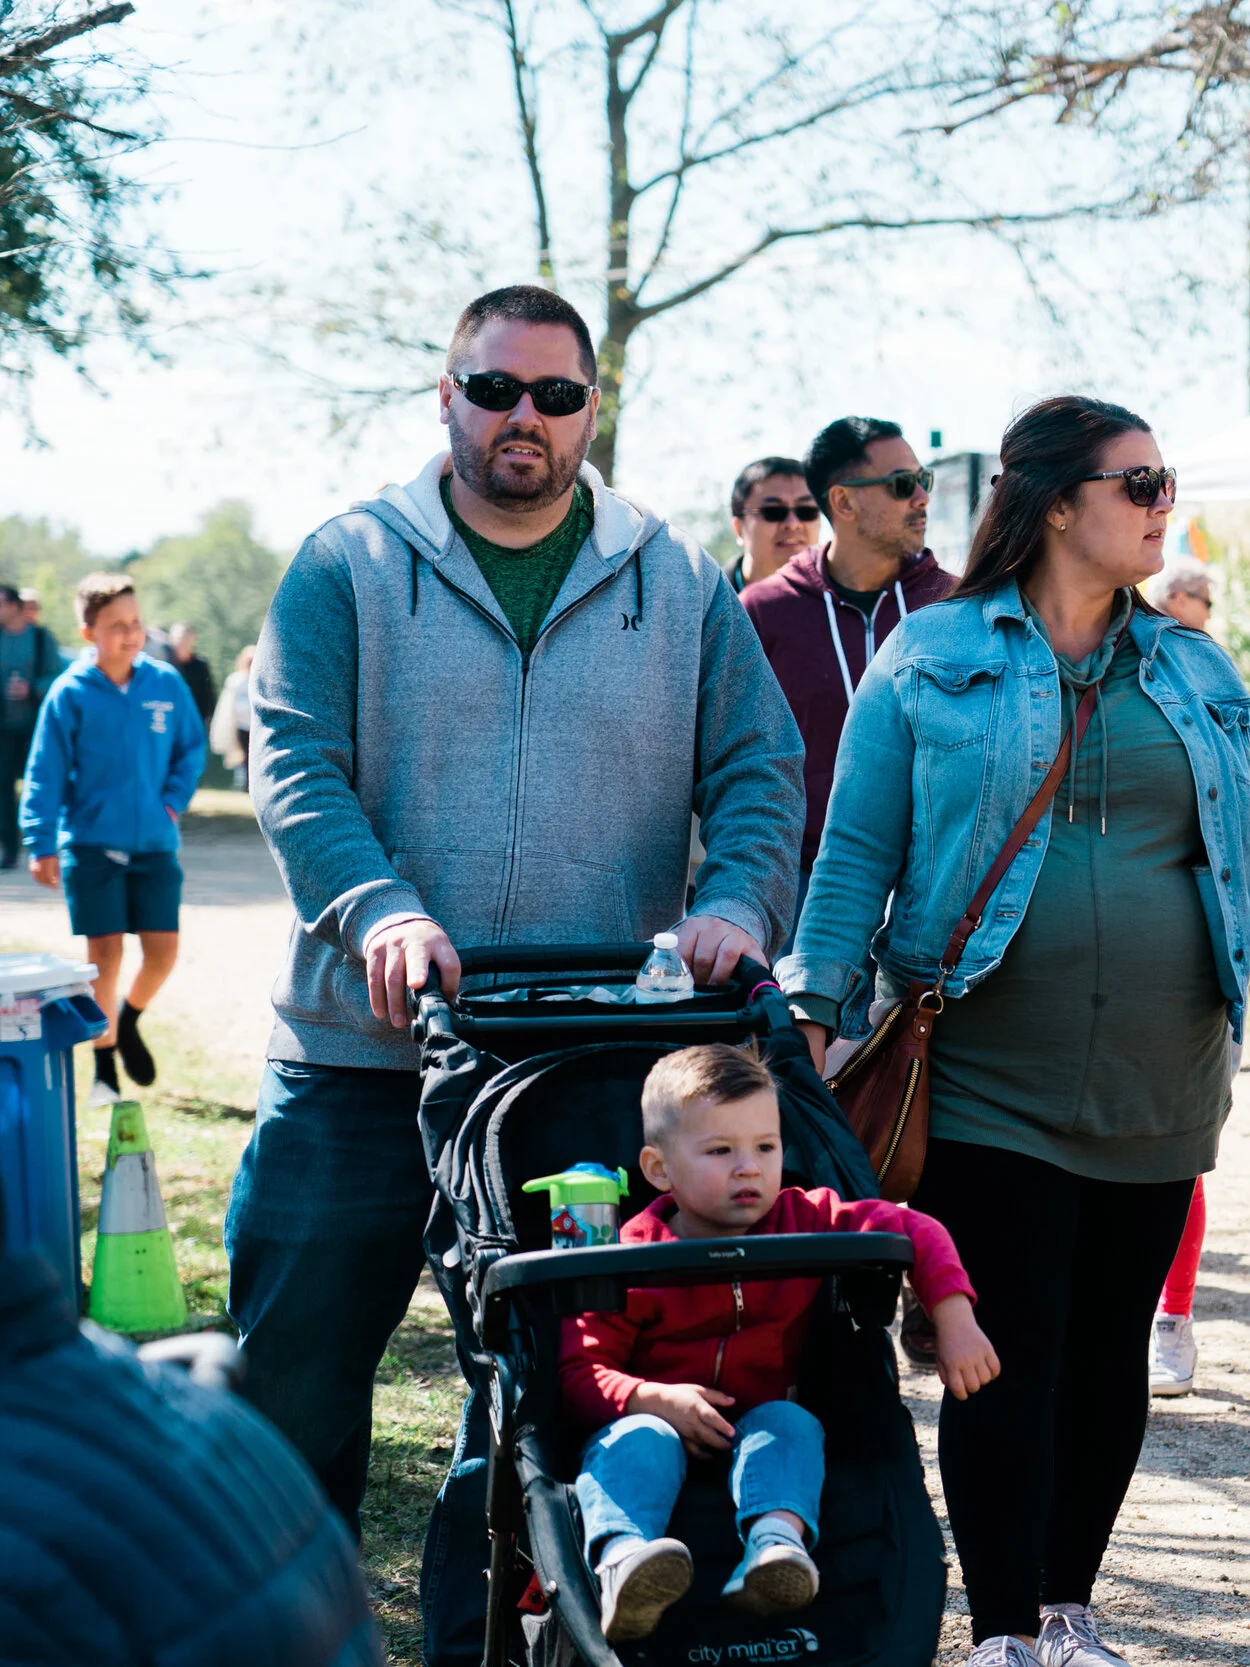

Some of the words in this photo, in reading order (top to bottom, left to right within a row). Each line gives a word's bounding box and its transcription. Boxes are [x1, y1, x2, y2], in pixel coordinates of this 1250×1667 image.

[688, 1644, 722, 1665] city
[728, 1637, 771, 1658] mini
[775, 1639, 798, 1654] GT
